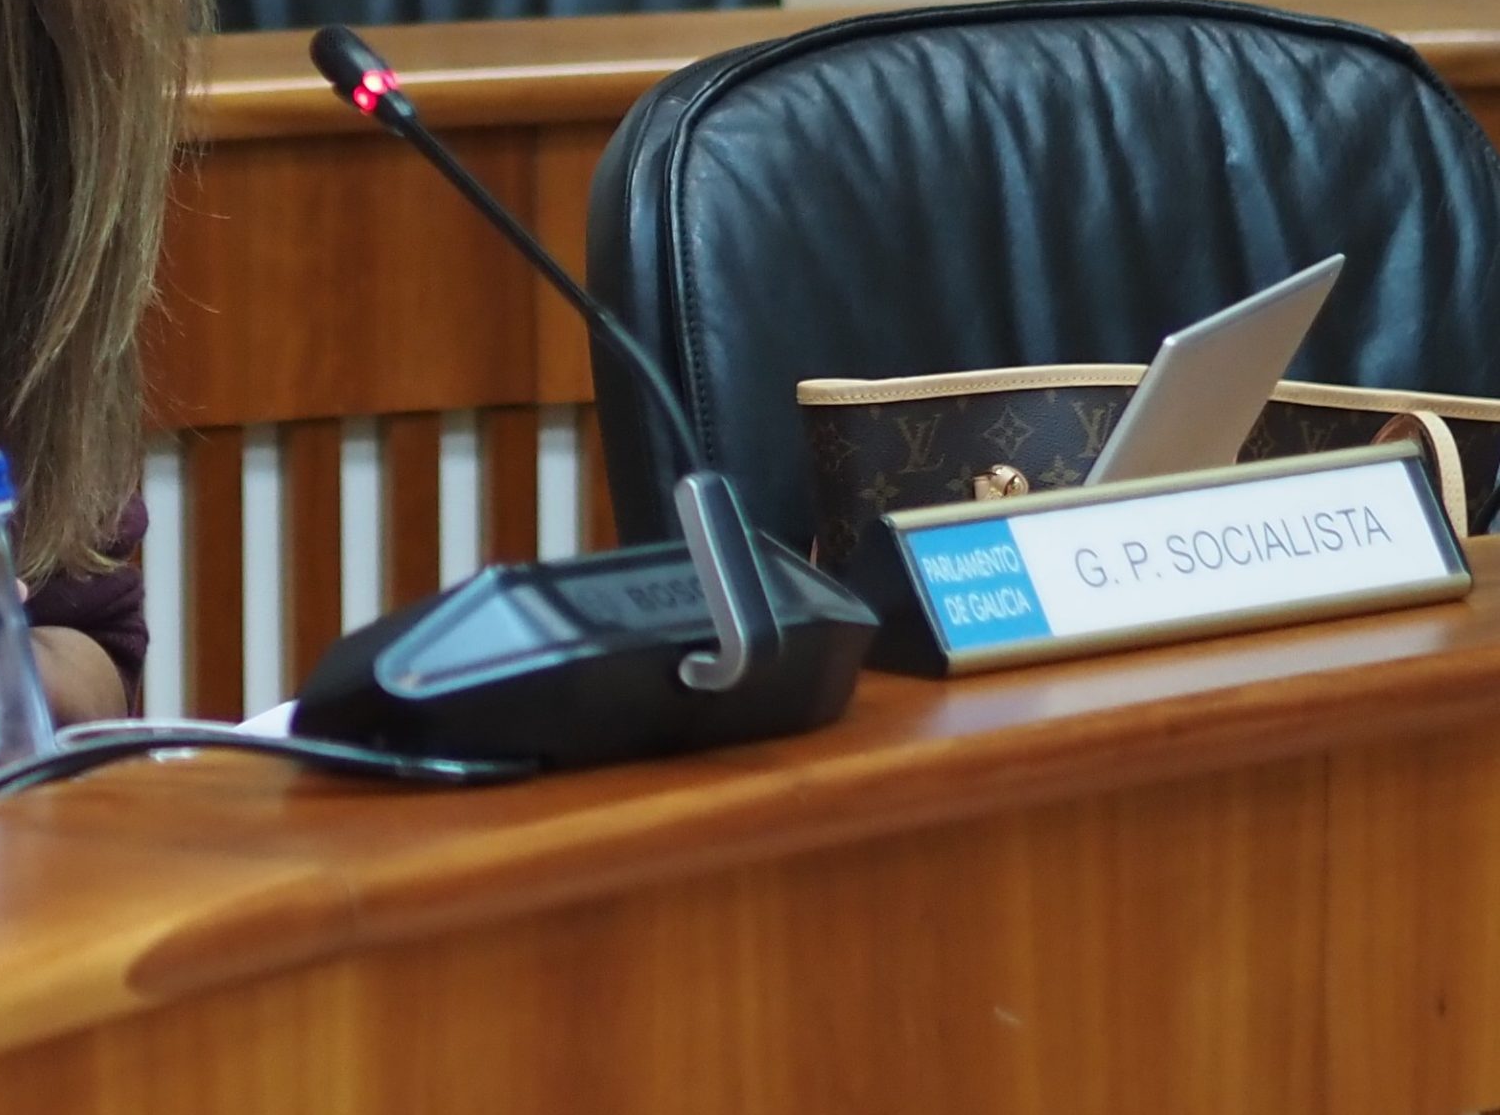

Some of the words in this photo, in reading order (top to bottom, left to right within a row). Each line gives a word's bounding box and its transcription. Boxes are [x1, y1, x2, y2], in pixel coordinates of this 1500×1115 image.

[921, 545, 1020, 583] PARLAMENTO
[1074, 547, 1119, 588] G.
[1122, 540, 1162, 581] P.
[1165, 505, 1393, 575] SOCIALISTA
[943, 595, 972, 626] DE
[968, 587, 1032, 622] GALICIA
